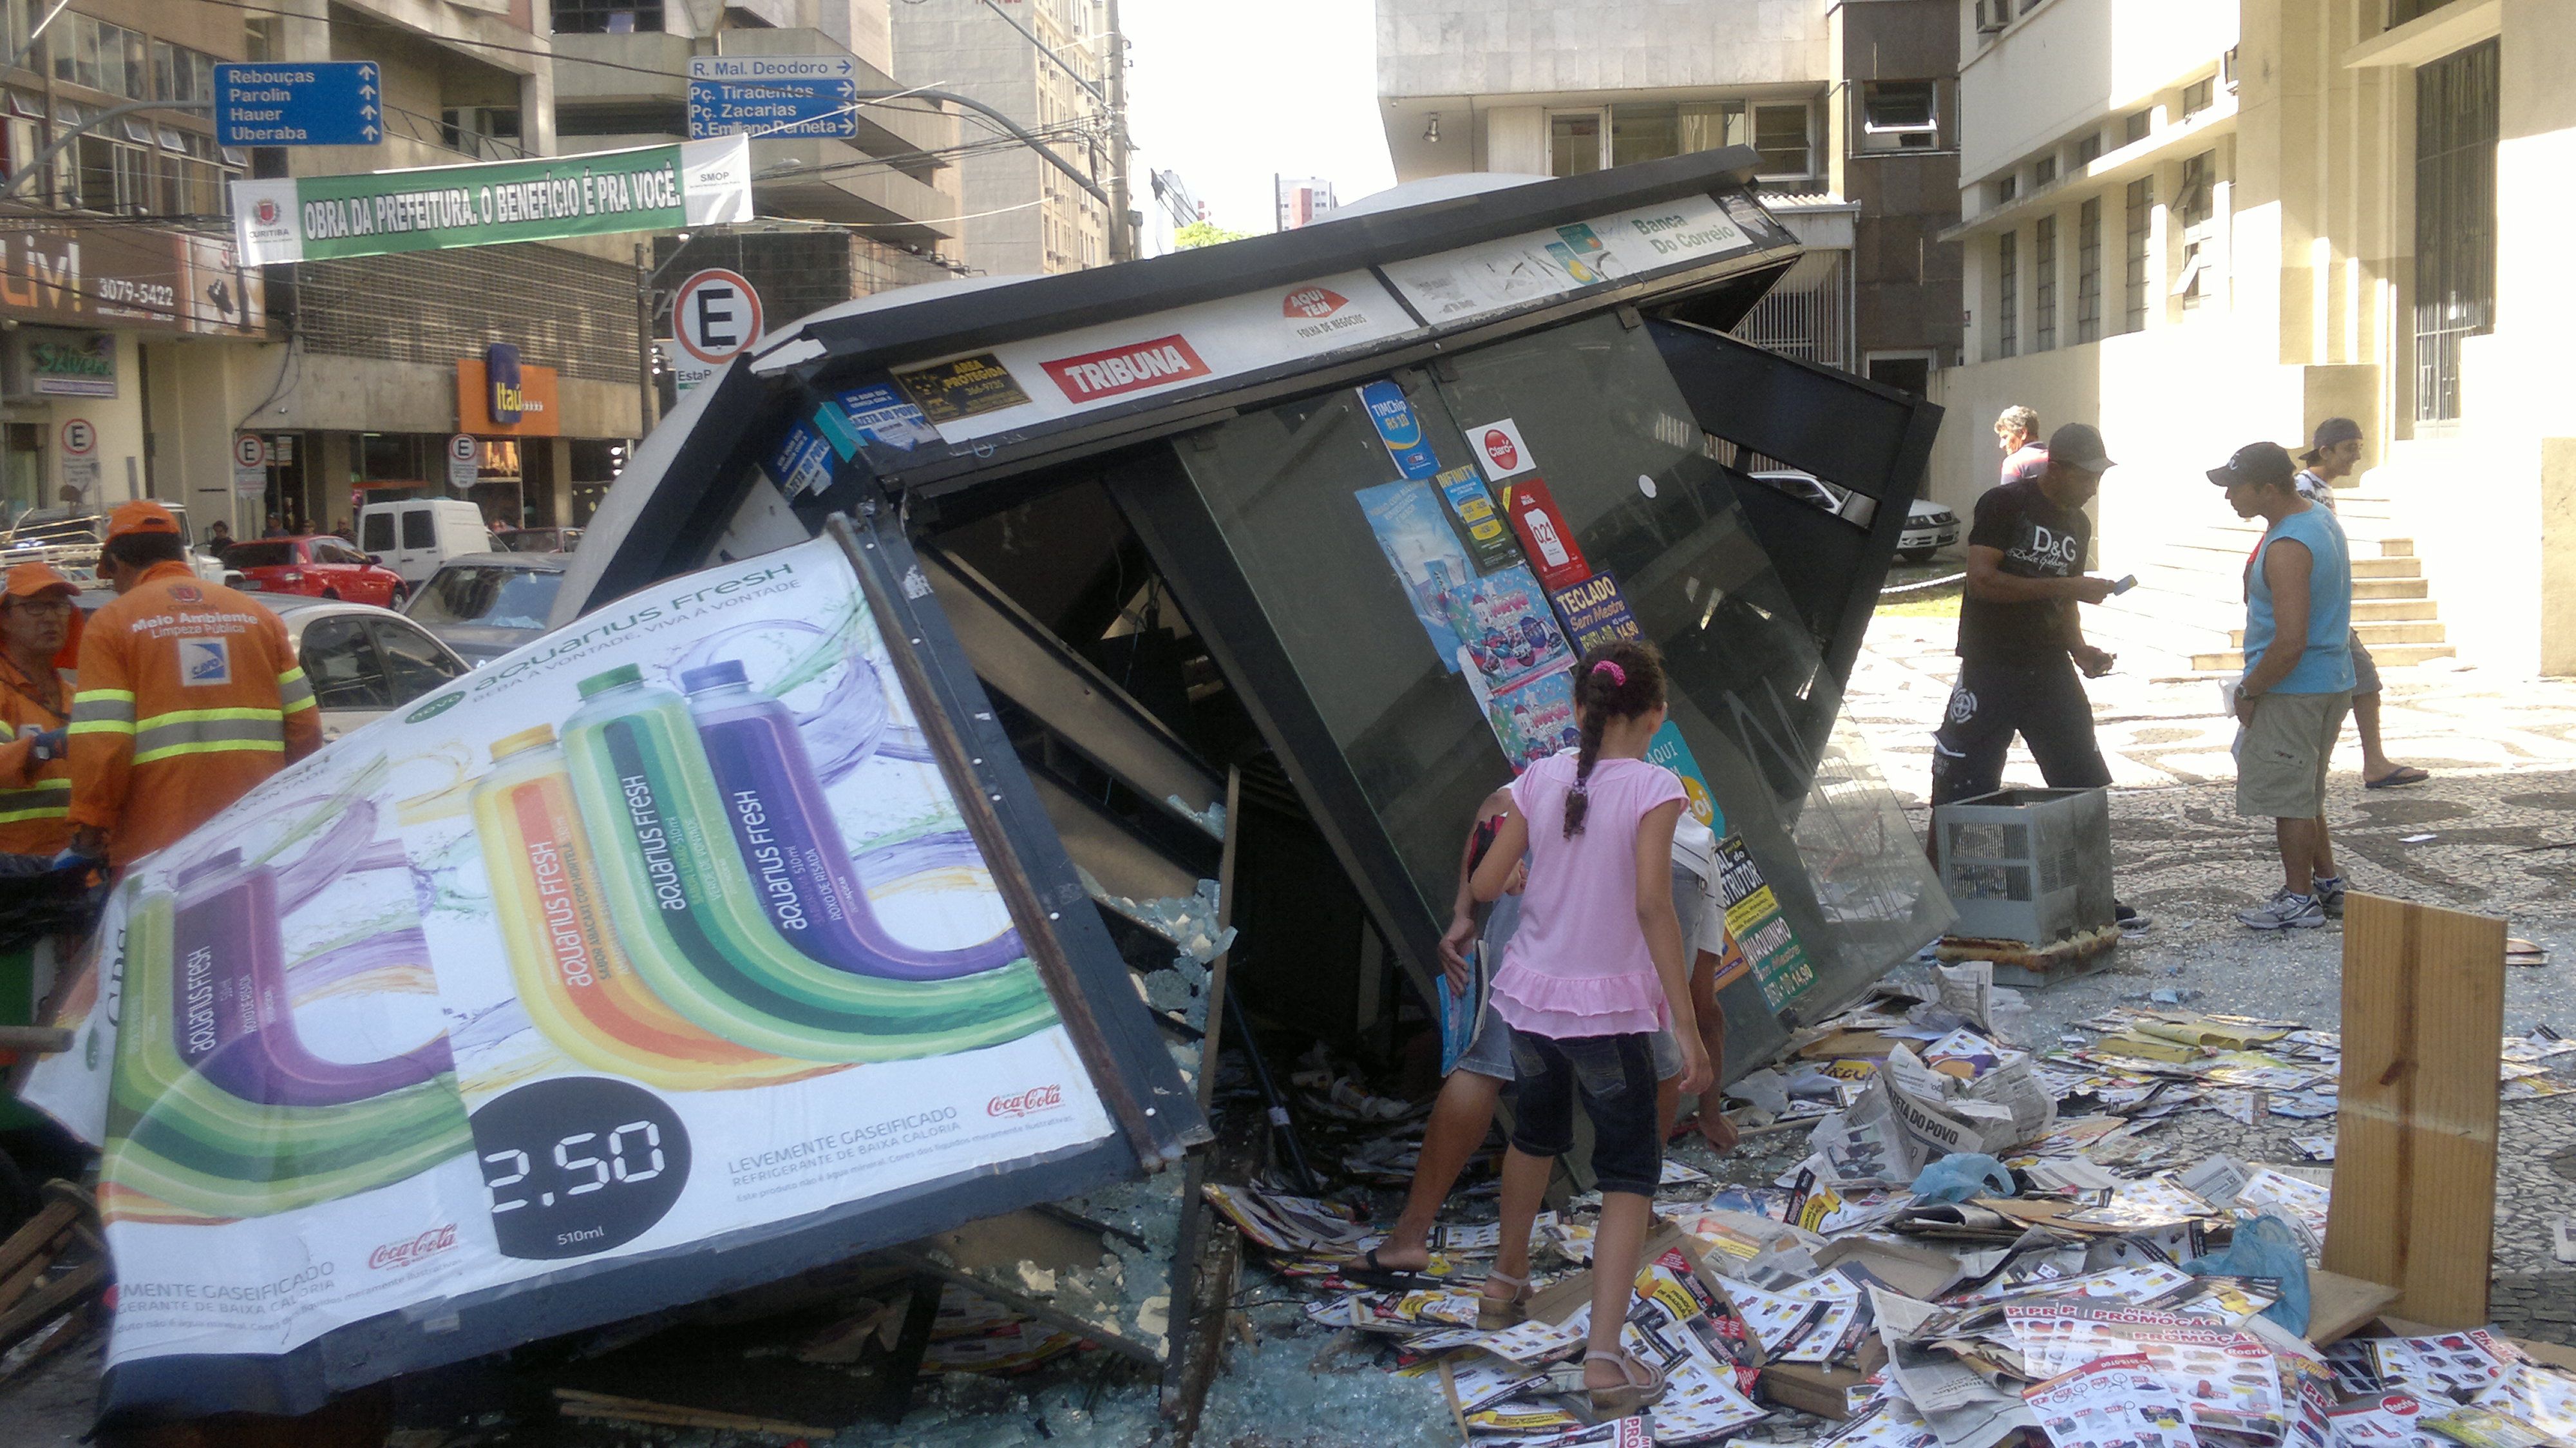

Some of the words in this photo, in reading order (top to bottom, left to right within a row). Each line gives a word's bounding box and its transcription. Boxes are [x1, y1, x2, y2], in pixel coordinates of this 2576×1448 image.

[229, 70, 316, 86] Rebouças
[694, 62, 709, 75] R.
[715, 62, 748, 75] Mal.
[754, 61, 828, 75] Deodoro
[230, 88, 291, 102] Parolin
[690, 87, 715, 103] Pç.
[721, 85, 814, 100] Tiradentes
[231, 108, 283, 121] Hauer
[691, 104, 716, 120] Pç.
[721, 103, 797, 117] Zacarias
[231, 126, 307, 140] Uberaba
[775, 120, 837, 135] Perneta
[700, 171, 730, 182] SMOP
[304, 198, 349, 240] OBRA
[350, 196, 374, 236] DA
[375, 187, 478, 234] PREFEITURA.
[480, 185, 493, 225] O
[497, 170, 580, 224] BENEFÍCIO
[582, 166, 596, 216] É
[597, 172, 631, 213] PRA
[631, 159, 681, 211] VOCÊ.
[249, 229, 289, 239] CURITIBA
[1631, 214, 1689, 235] Banca
[1649, 238, 1679, 254] Do
[1679, 224, 1735, 249] Correio
[100, 278, 174, 307] 3079-5422
[1291, 289, 1325, 307] AQUI
[697, 287, 737, 347] E
[1302, 301, 1332, 318] TEM
[1296, 325, 1321, 339] FOLHA
[1323, 323, 1332, 332] DE
[943, 366, 1008, 388] PROTEGIDA
[1065, 344, 1191, 394] TRIBUNA
[496, 385, 523, 412] Itaú
[895, 405, 920, 419] POVO
[71, 425, 85, 447] E
[244, 442, 255, 461] E
[458, 439, 470, 456] E
[1488, 441, 1511, 458] Claro
[1435, 464, 1479, 488] INFINITY
[2032, 525, 2077, 562] D&G
[644, 614, 690, 633] VIVA
[711, 579, 802, 611] VONTADE
[1556, 576, 1616, 616] TECLADO
[131, 614, 175, 633] Meio
[180, 612, 258, 625] Ambiente
[1569, 614, 1593, 633] Sem
[1592, 599, 1625, 623] Mestre
[151, 624, 202, 640] Limpeza
[1646, 741, 1678, 766] AQUI
[1694, 790, 1712, 817] oi
[784, 844, 807, 874] 510ml
[806, 847, 828, 881] RISADA
[1733, 850, 1745, 862] do
[573, 882, 588, 903] COM
[817, 881, 833, 895] DE
[824, 895, 844, 921] ROXO
[1791, 963, 1814, 989] 14,90
[987, 1083, 1061, 1118] Coca-Cola
[1909, 1108, 1926, 1129] DO
[1925, 1119, 1959, 1147] POVO
[727, 1134, 838, 1176] LEVEMENTE
[840, 1105, 958, 1146] GASEIFICADO
[732, 1154, 834, 1188] REFRIGERANTE
[838, 1149, 855, 1161] DE
[860, 1138, 900, 1156] BAIXA
[903, 1121, 962, 1145] CALORIA
[736, 1192, 758, 1203] Este
[760, 1183, 798, 1199] produto
[917, 1146, 933, 1156] dos
[971, 1125, 1023, 1143] meramente
[368, 1223, 459, 1270] Coca-Cola
[557, 1226, 605, 1246] 510ml
[202, 1261, 335, 1302] GASEIFICADO
[196, 1301, 213, 1313] DE
[219, 1302, 266, 1315] BAIXA
[2125, 1307, 2176, 1319] MEGA
[2162, 1328, 2216, 1337] MEGA
